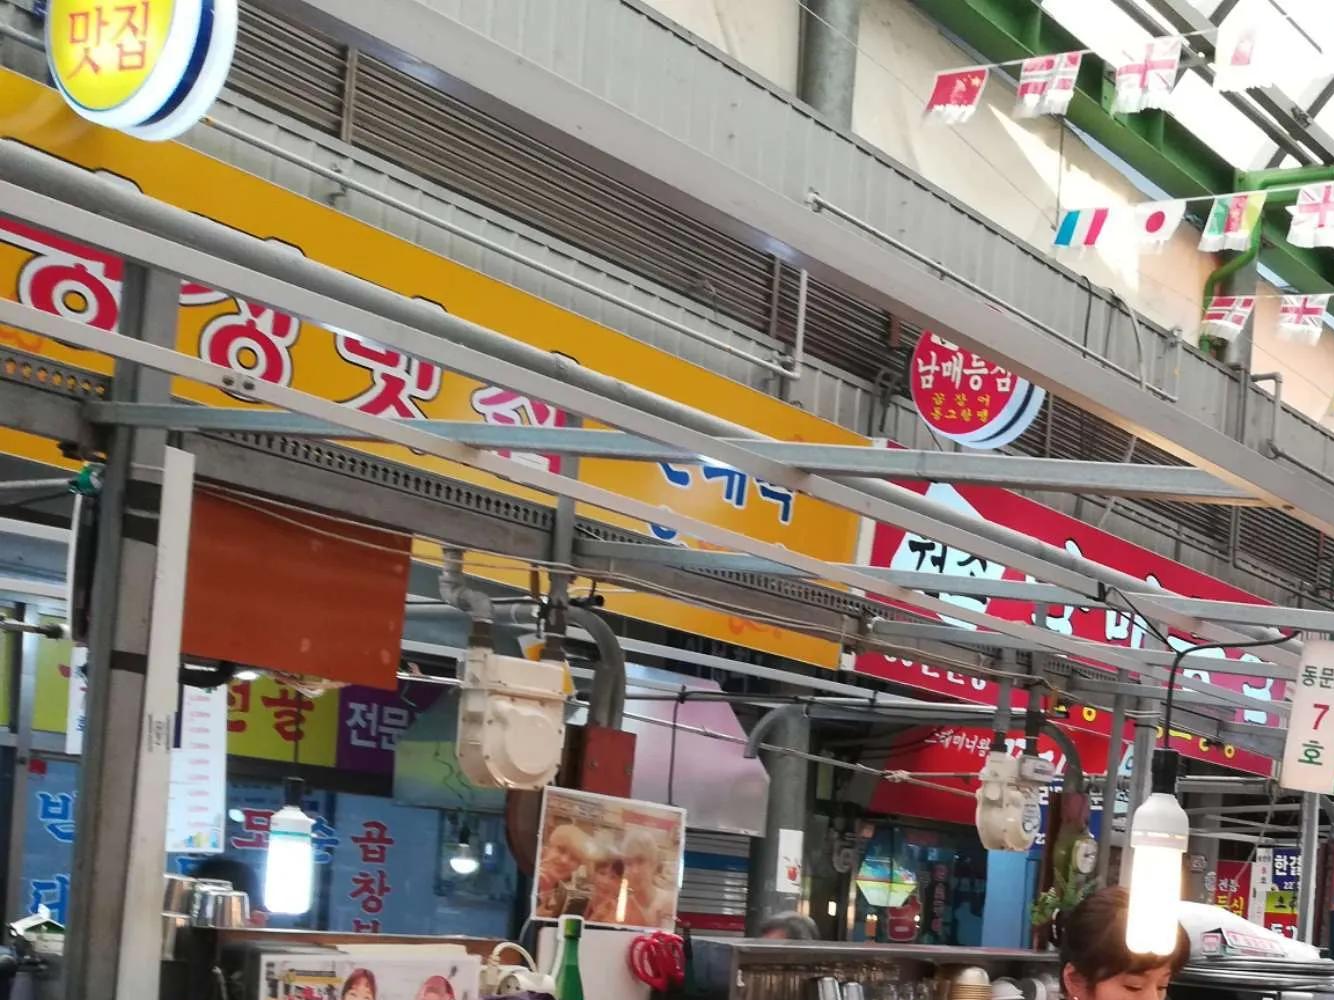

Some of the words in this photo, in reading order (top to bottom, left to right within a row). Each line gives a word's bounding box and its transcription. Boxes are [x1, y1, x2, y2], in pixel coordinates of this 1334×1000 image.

[66, 1, 152, 80] 맛집
[917, 351, 1012, 392] 남매등심
[1312, 703, 1330, 731] 7
[1297, 741, 1324, 766] 호
